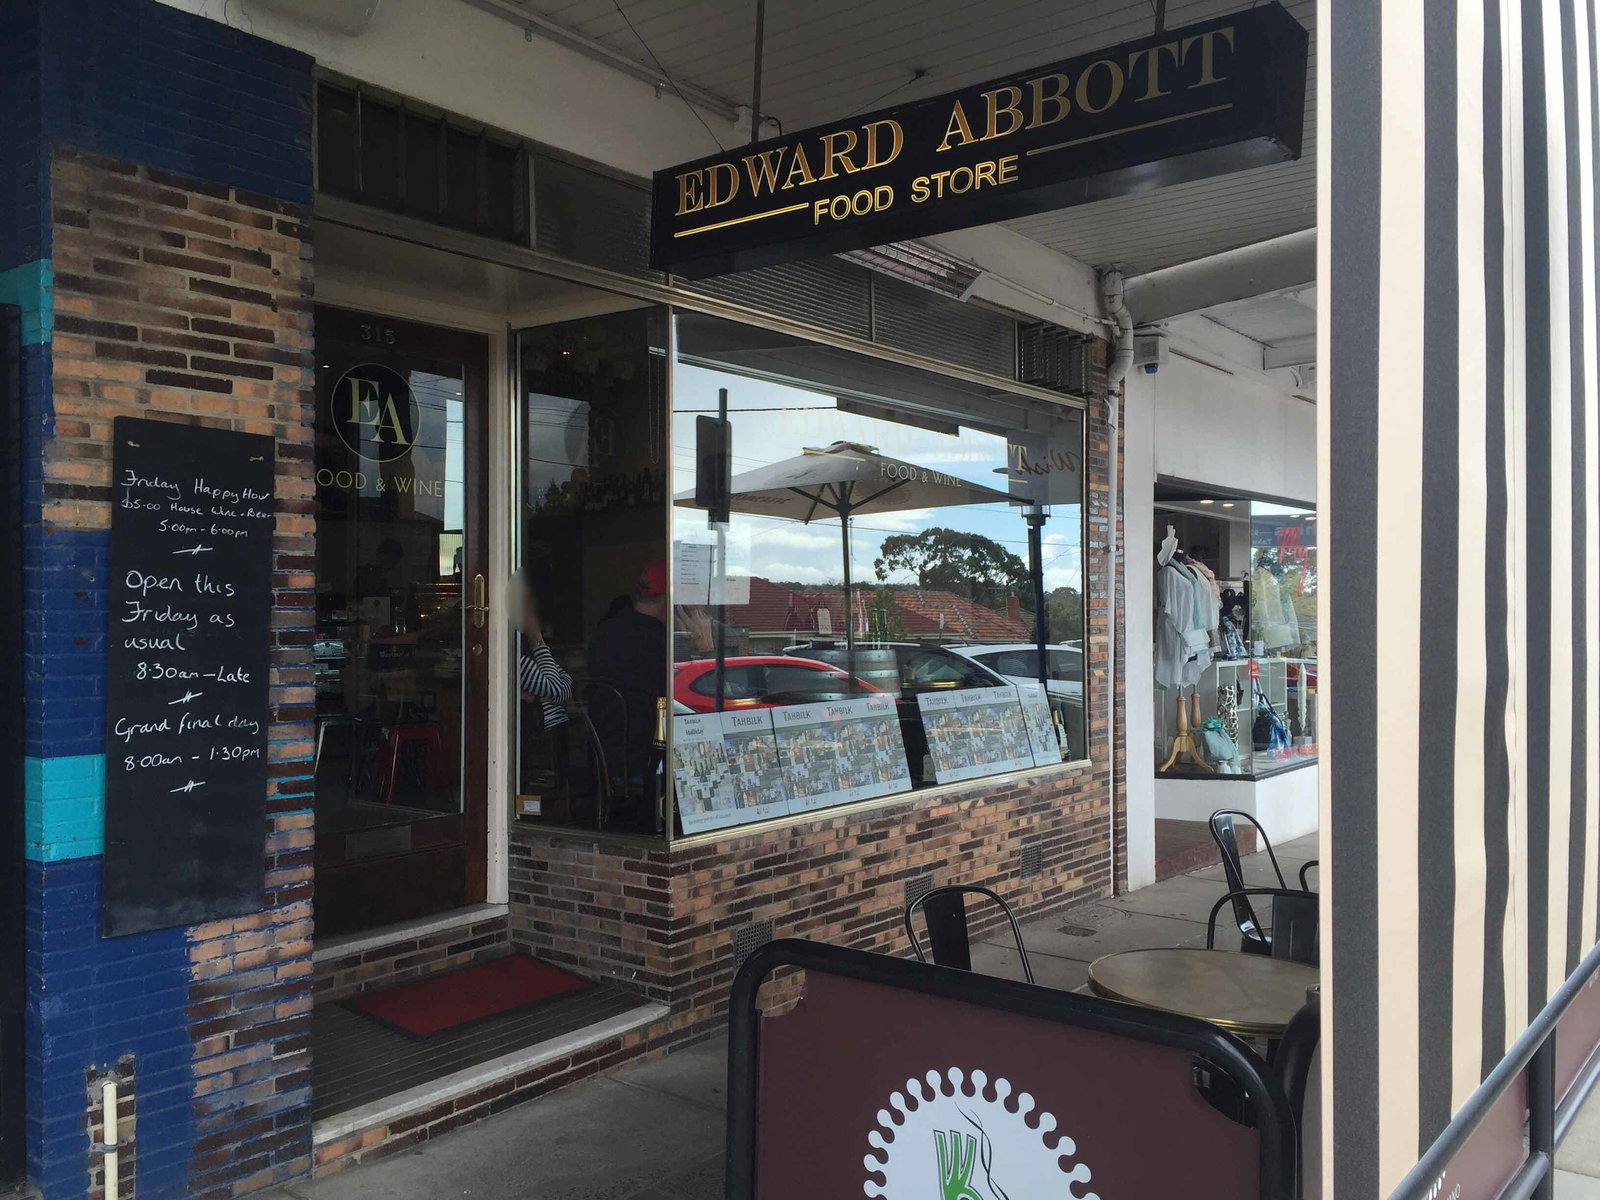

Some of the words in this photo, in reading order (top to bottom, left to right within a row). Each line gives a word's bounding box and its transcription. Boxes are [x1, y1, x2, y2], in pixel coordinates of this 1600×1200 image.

[674, 119, 904, 216] EDWARD
[936, 26, 1235, 152] ABBOTT
[814, 185, 894, 225] FOOD
[911, 154, 1019, 203] STORE
[360, 323, 396, 345] 315
[346, 376, 412, 446] EA
[121, 469, 181, 500] Friday
[194, 478, 239, 503] Happy
[316, 468, 367, 490] OOD
[375, 477, 386, 492] &
[394, 476, 443, 497] WINE
[881, 462, 917, 481] FOOD
[921, 471, 928, 483] &
[170, 503, 203, 515] House
[125, 569, 183, 597] Open
[194, 573, 235, 597] this
[122, 600, 198, 630] Friday
[209, 613, 235, 627] as
[124, 633, 185, 650] usual
[731, 715, 763, 727] TAHBILK
[783, 710, 812, 722] TAHBILK
[826, 706, 853, 717] TAHBILK
[115, 717, 171, 742] Grand
[178, 712, 222, 734] final
[228, 716, 260, 734] day
